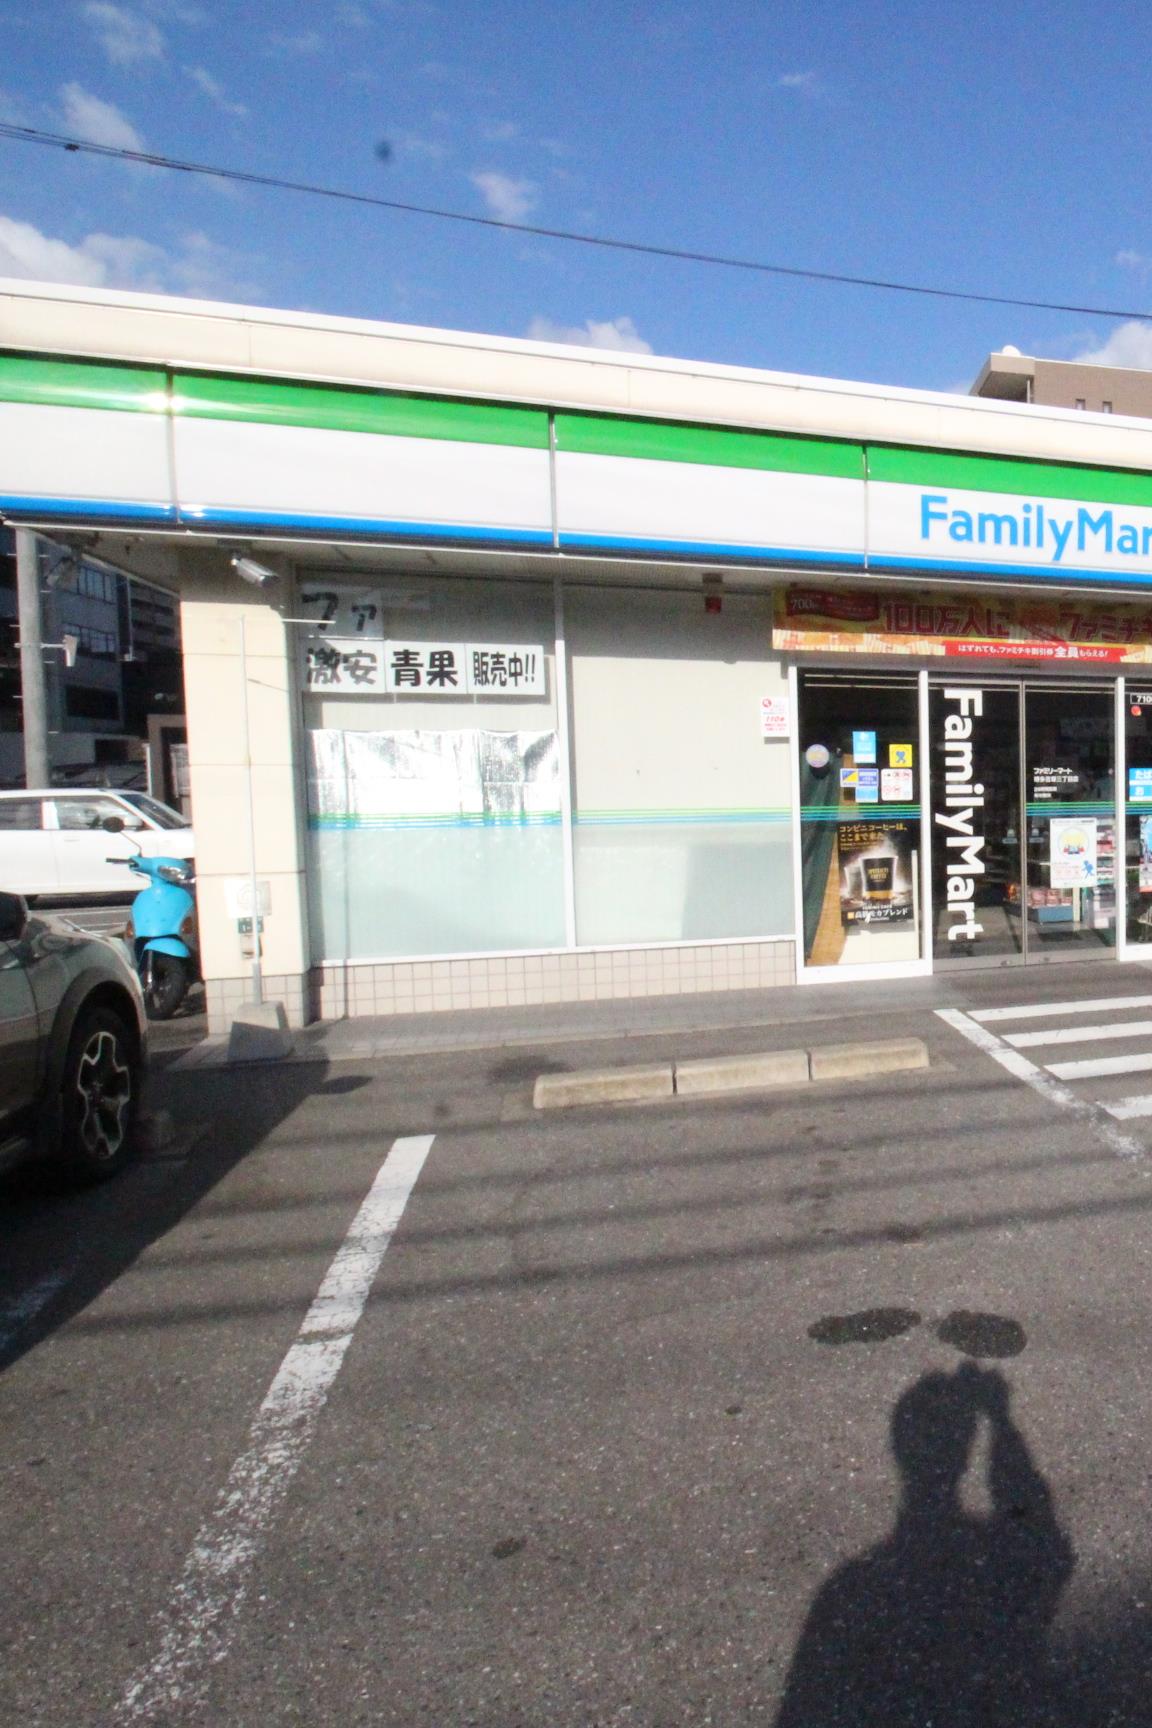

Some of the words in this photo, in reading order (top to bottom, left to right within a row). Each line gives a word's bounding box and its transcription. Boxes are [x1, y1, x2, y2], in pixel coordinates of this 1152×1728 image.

[306, 648, 378, 686] 激安
[391, 649, 459, 687] 青果
[473, 651, 535, 687] 販売中!!
[935, 689, 985, 941] FamilyMart
